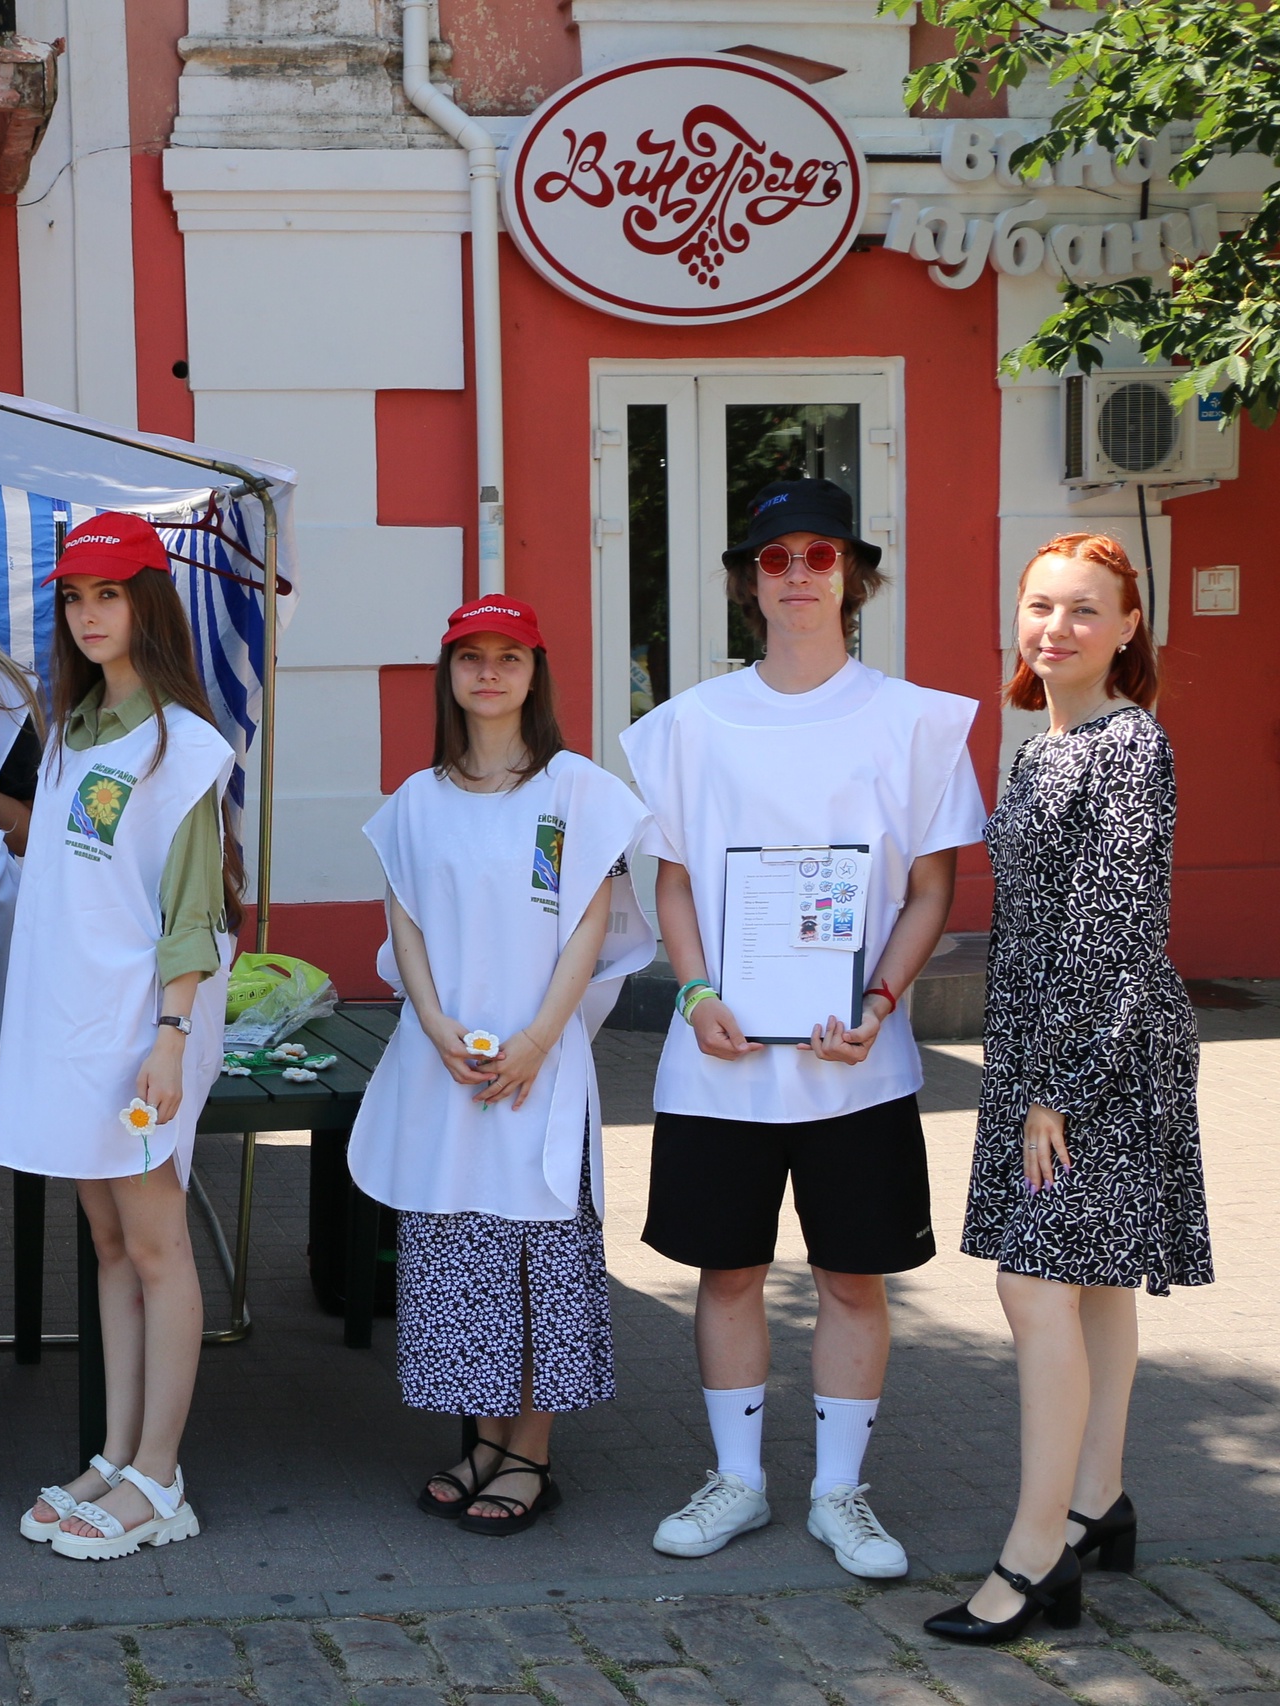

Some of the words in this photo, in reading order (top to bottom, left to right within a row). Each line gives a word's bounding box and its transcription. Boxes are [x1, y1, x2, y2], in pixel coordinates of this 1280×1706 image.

[65, 534, 120, 549] ВОЛОНТЁР
[91, 763, 116, 775] ЕЙСКИЙ
[113, 769, 138, 786] РАЙОН
